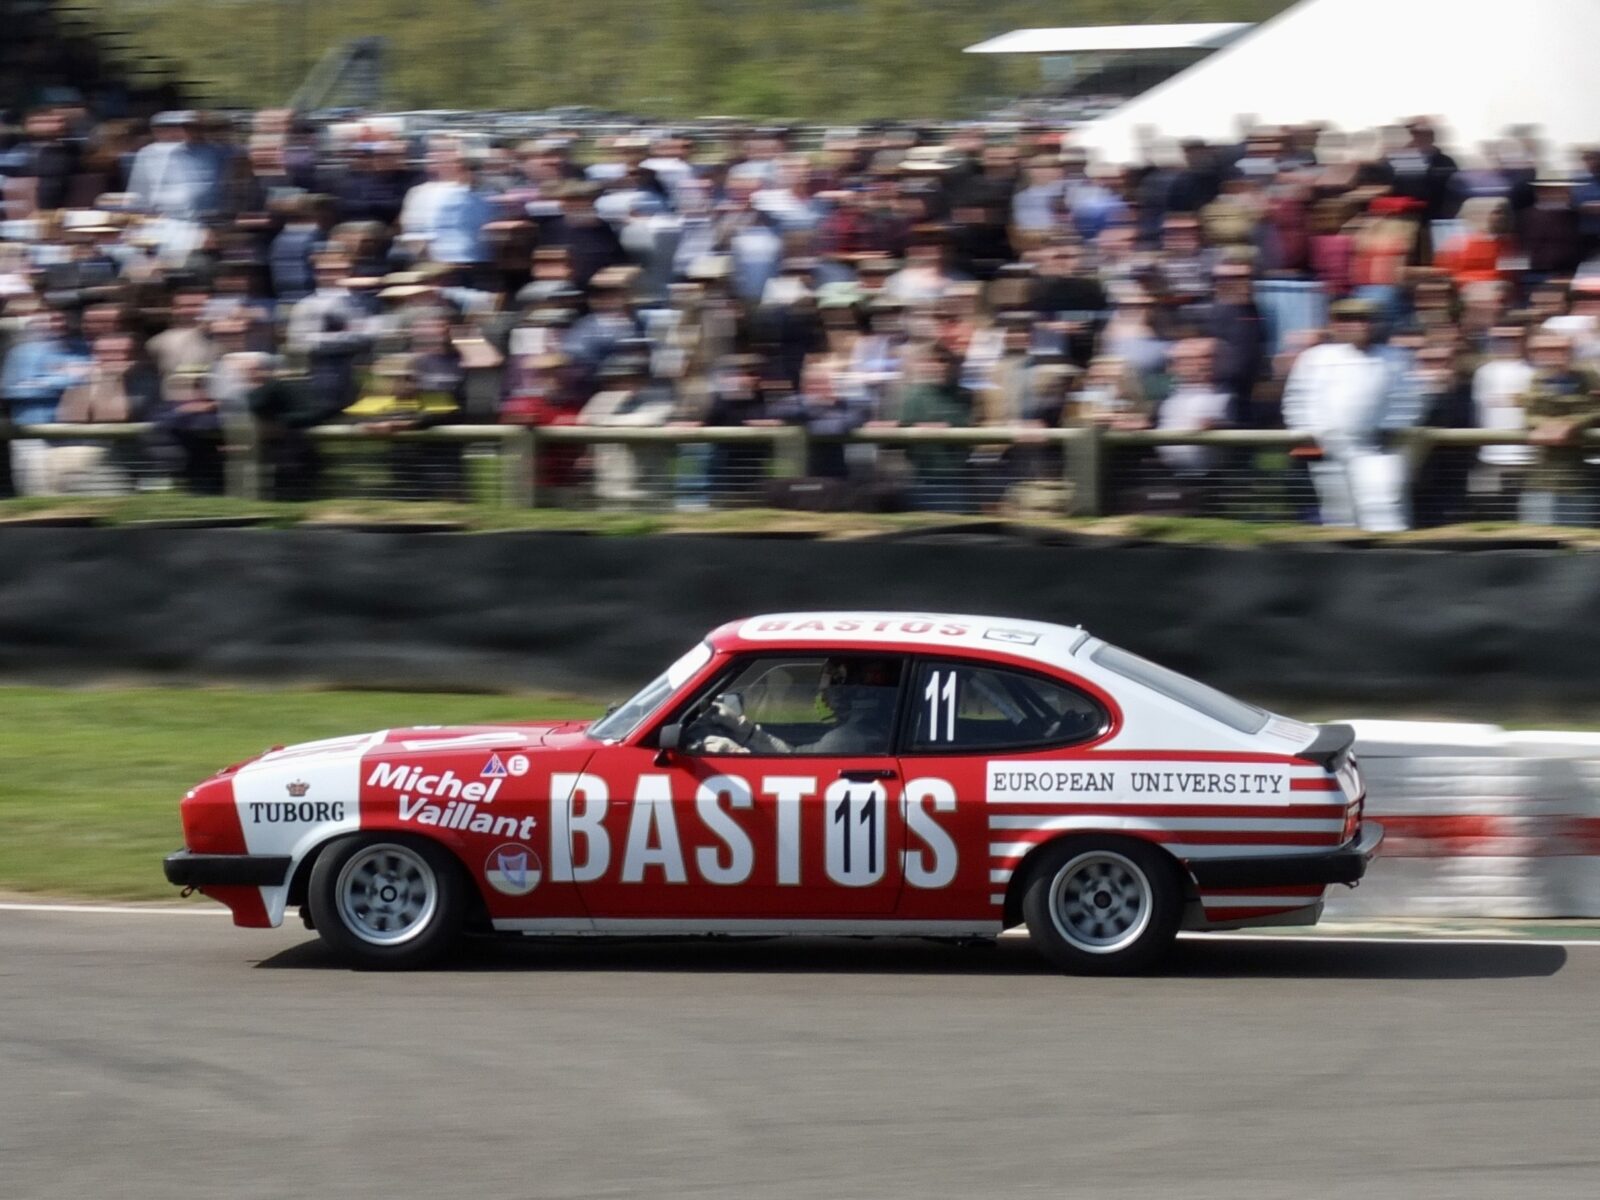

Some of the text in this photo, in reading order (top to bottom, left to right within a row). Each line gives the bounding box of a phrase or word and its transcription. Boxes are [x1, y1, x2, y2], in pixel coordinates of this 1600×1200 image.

[757, 619, 972, 636] BASTOS
[925, 671, 957, 742] 11
[366, 762, 503, 803] Michel
[513, 758, 525, 771] E
[993, 772, 1283, 794] EUROPEAN UNIVERSITY
[249, 801, 345, 824] TUBORG
[398, 794, 537, 840] Vaillant
[550, 772, 959, 889] BASTOS
[834, 790, 876, 874] 11
